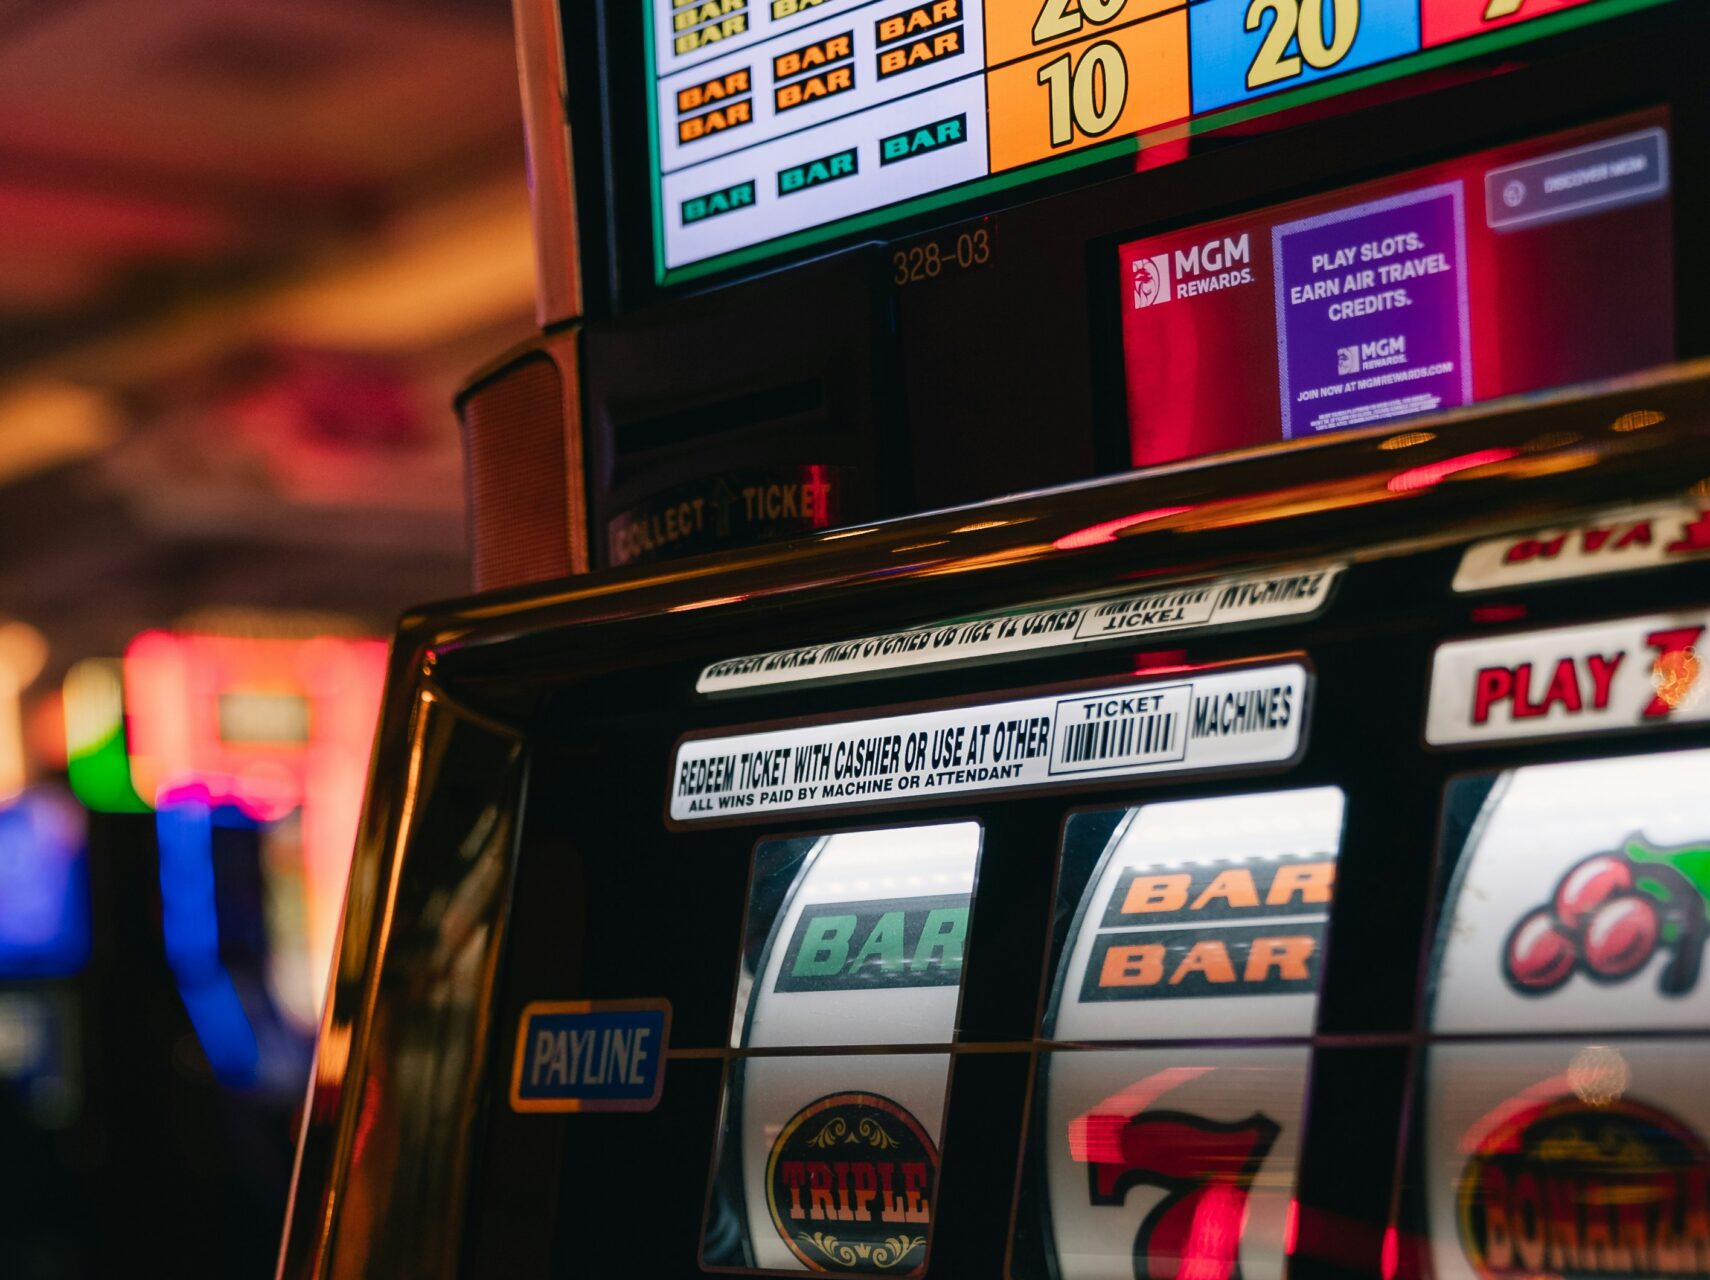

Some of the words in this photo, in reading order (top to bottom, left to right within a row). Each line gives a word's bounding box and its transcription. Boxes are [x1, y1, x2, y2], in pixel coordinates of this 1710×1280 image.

[675, 14, 746, 55] BAR
[880, 0, 958, 42] BAR
[1245, 0, 1361, 90] 20
[776, 35, 850, 79] BAR
[881, 31, 959, 75] BAR
[678, 69, 749, 112] BAR
[777, 67, 851, 111] BAR
[1037, 40, 1129, 149] 10
[680, 100, 751, 143] BAR
[684, 183, 752, 222] BAR
[781, 151, 855, 194] BAR
[884, 119, 961, 160] BAR
[893, 228, 990, 286] 328-03
[1174, 233, 1250, 279] MGM
[1312, 246, 1357, 273] PLAY
[1360, 232, 1425, 261] SLOTS.
[1291, 277, 1340, 304] EARN
[1343, 269, 1375, 293] AIR
[1378, 252, 1451, 285] TRAVEL
[1328, 289, 1413, 321] CREDITS.
[1361, 335, 1406, 360] MGM
[1297, 388, 1319, 402] JOIN
[1320, 385, 1343, 398] NOW
[1344, 381, 1357, 393] AT
[614, 497, 705, 567] COLLECT
[742, 480, 832, 522] TICKET
[1083, 695, 1164, 720] TICKET
[1471, 650, 1626, 726] PLAY
[677, 754, 737, 797] REDEEM
[739, 748, 791, 790] TICKET
[793, 742, 833, 784] WITH
[833, 734, 902, 780] CASHIER
[904, 731, 929, 773] OR
[930, 726, 965, 769] USE
[965, 723, 991, 766] AT
[992, 716, 1051, 763] OTHER
[1191, 685, 1293, 739] MACHINES
[688, 799, 714, 813] ALL
[718, 793, 755, 810] WINS
[759, 790, 794, 806] PAID
[798, 787, 816, 801] BY
[821, 779, 893, 799] MACHINE
[897, 775, 921, 790] OR
[924, 763, 1024, 788] ATTENDANT
[1119, 861, 1336, 915] BAR
[791, 907, 968, 977] BAR
[1099, 934, 1317, 988] BAR
[531, 1028, 651, 1085] PAYLINE
[782, 1160, 930, 1224] TRIPLE
